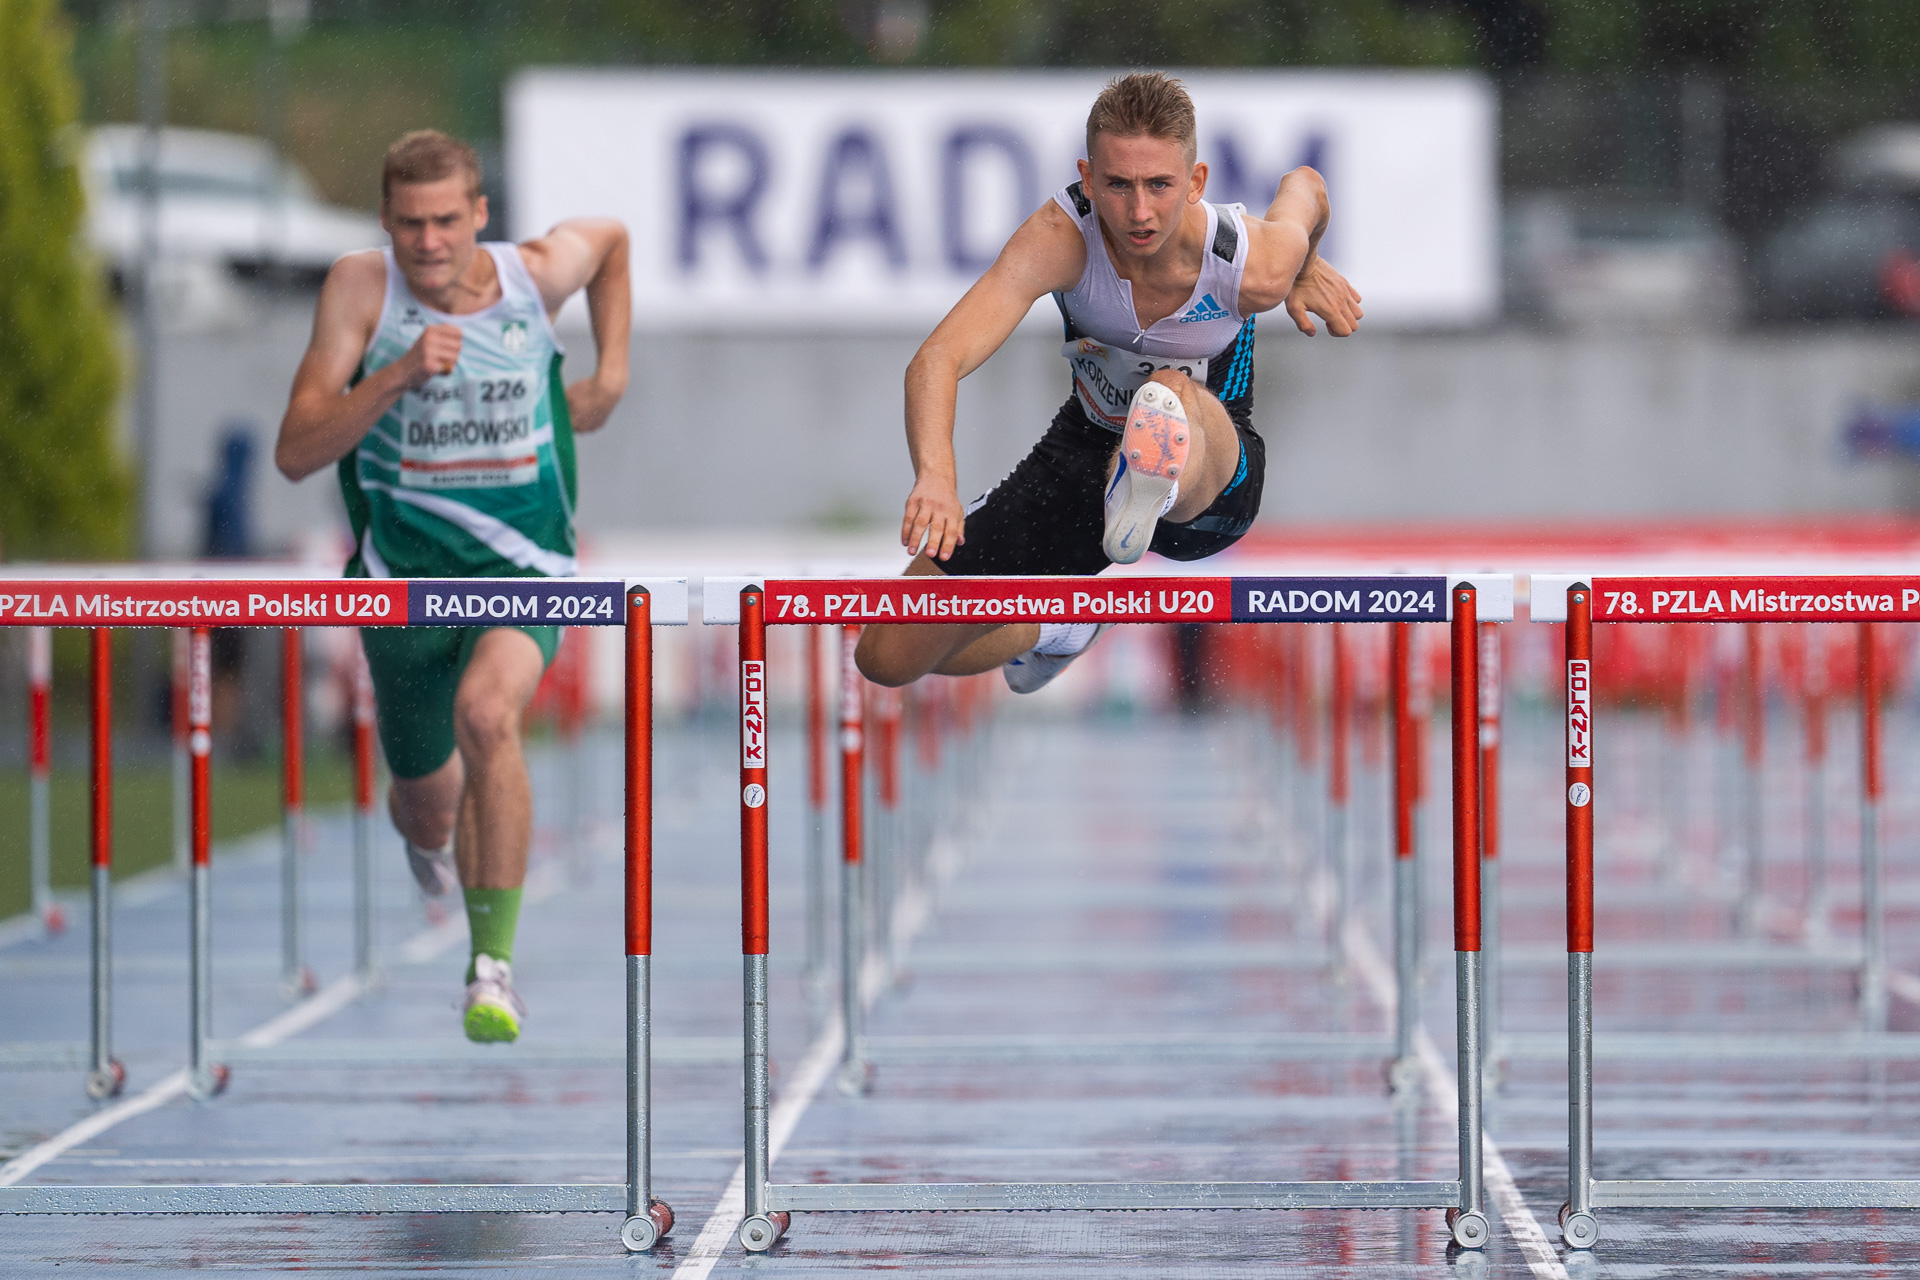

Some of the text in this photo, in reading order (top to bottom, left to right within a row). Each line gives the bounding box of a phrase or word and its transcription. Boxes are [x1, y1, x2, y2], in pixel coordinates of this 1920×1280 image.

[673, 122, 1335, 273] RADM
[1179, 310, 1229, 324] adidas
[481, 380, 526, 402] 226
[1075, 358, 1135, 407] KORZENI
[408, 416, 529, 452] DĄBROWSKI
[1090, 412, 1124, 432] RADO
[0, 593, 391, 617] PZLA Mistrzostwa Polski U20
[425, 594, 614, 619] RADOM 2024
[776, 590, 1214, 618] 78. PZLA Mistrzostwa Polski U20
[1249, 590, 1435, 614] RADOM 2024
[1604, 588, 1920, 615] 78. PZLA Mistrzostwa P
[745, 663, 763, 759] POLANIK
[1570, 662, 1588, 758] POLANIK
